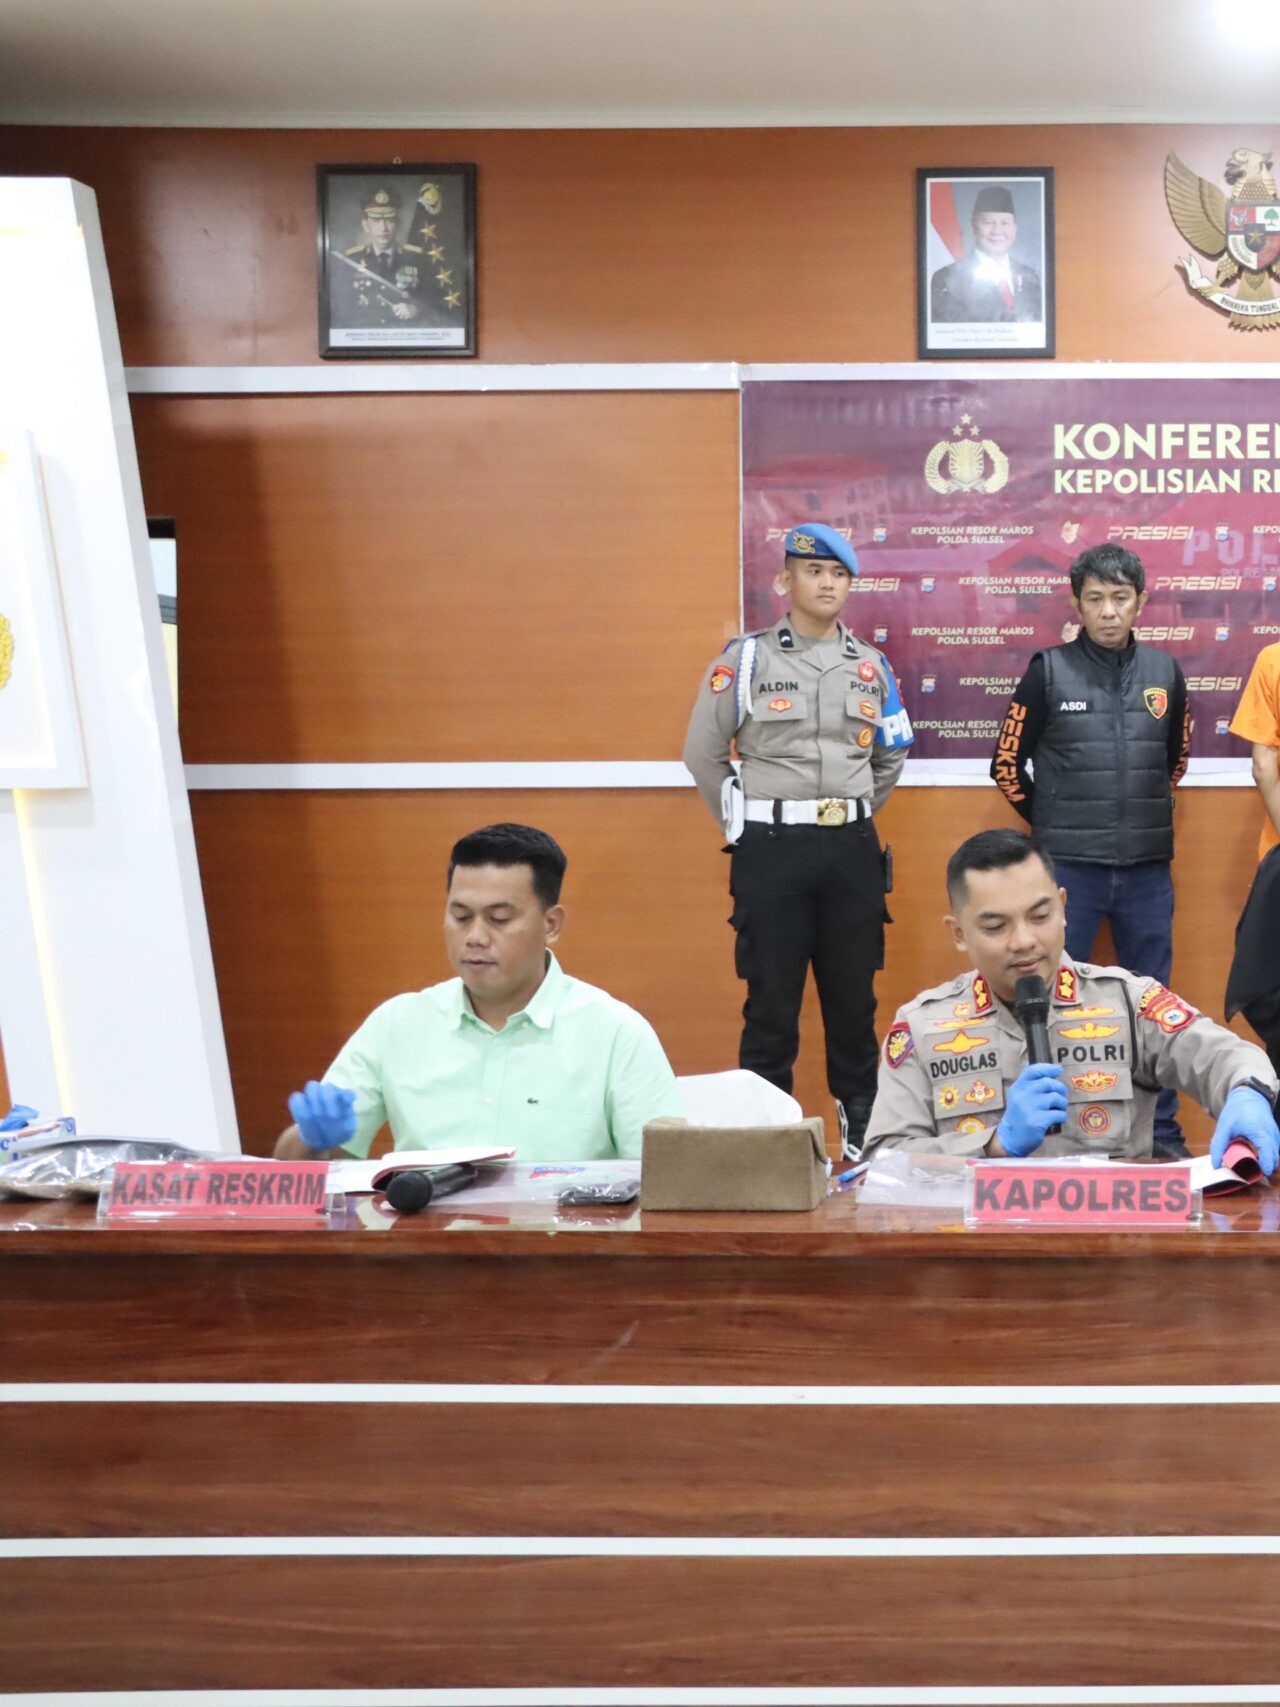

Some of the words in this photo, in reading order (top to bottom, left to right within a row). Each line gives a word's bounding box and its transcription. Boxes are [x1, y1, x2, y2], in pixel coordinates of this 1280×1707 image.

[1054, 468, 1241, 495] KEPOLISIAN
[967, 526, 997, 535] RESOR
[1000, 526, 1034, 535] MAROS
[1107, 526, 1194, 540] PRESISI
[937, 535, 969, 544] POLDA
[971, 535, 1004, 544] SULSEL
[849, 578, 900, 592] ESISI
[1014, 577, 1045, 585] RESOR
[1047, 577, 1071, 585] MAR
[1155, 576, 1242, 591] PRESISI
[985, 586, 1017, 594] POLDA
[1019, 586, 1053, 594] SULSEL
[967, 627, 998, 636] RESOR
[1000, 627, 1034, 635] MAROS
[1132, 626, 1195, 641] ESISI
[937, 636, 969, 644] POLDA
[972, 636, 1005, 644] SULSEL
[758, 681, 799, 693] ALDIN
[850, 681, 880, 697] POLRI
[1186, 677, 1242, 691] ESISI
[1060, 701, 1087, 711] ASDI
[967, 721, 998, 729] RESOR
[938, 729, 970, 738] POLDA
[972, 729, 1001, 738] SULSE
[995, 701, 1027, 802] RESKRIM
[1057, 1043, 1126, 1063] POLRI
[930, 1052, 997, 1078] DOUGLAS
[112, 1173, 199, 1206] KASAT
[206, 1173, 326, 1206] RESKRIM
[974, 1179, 1189, 1212] KAPOLRES
